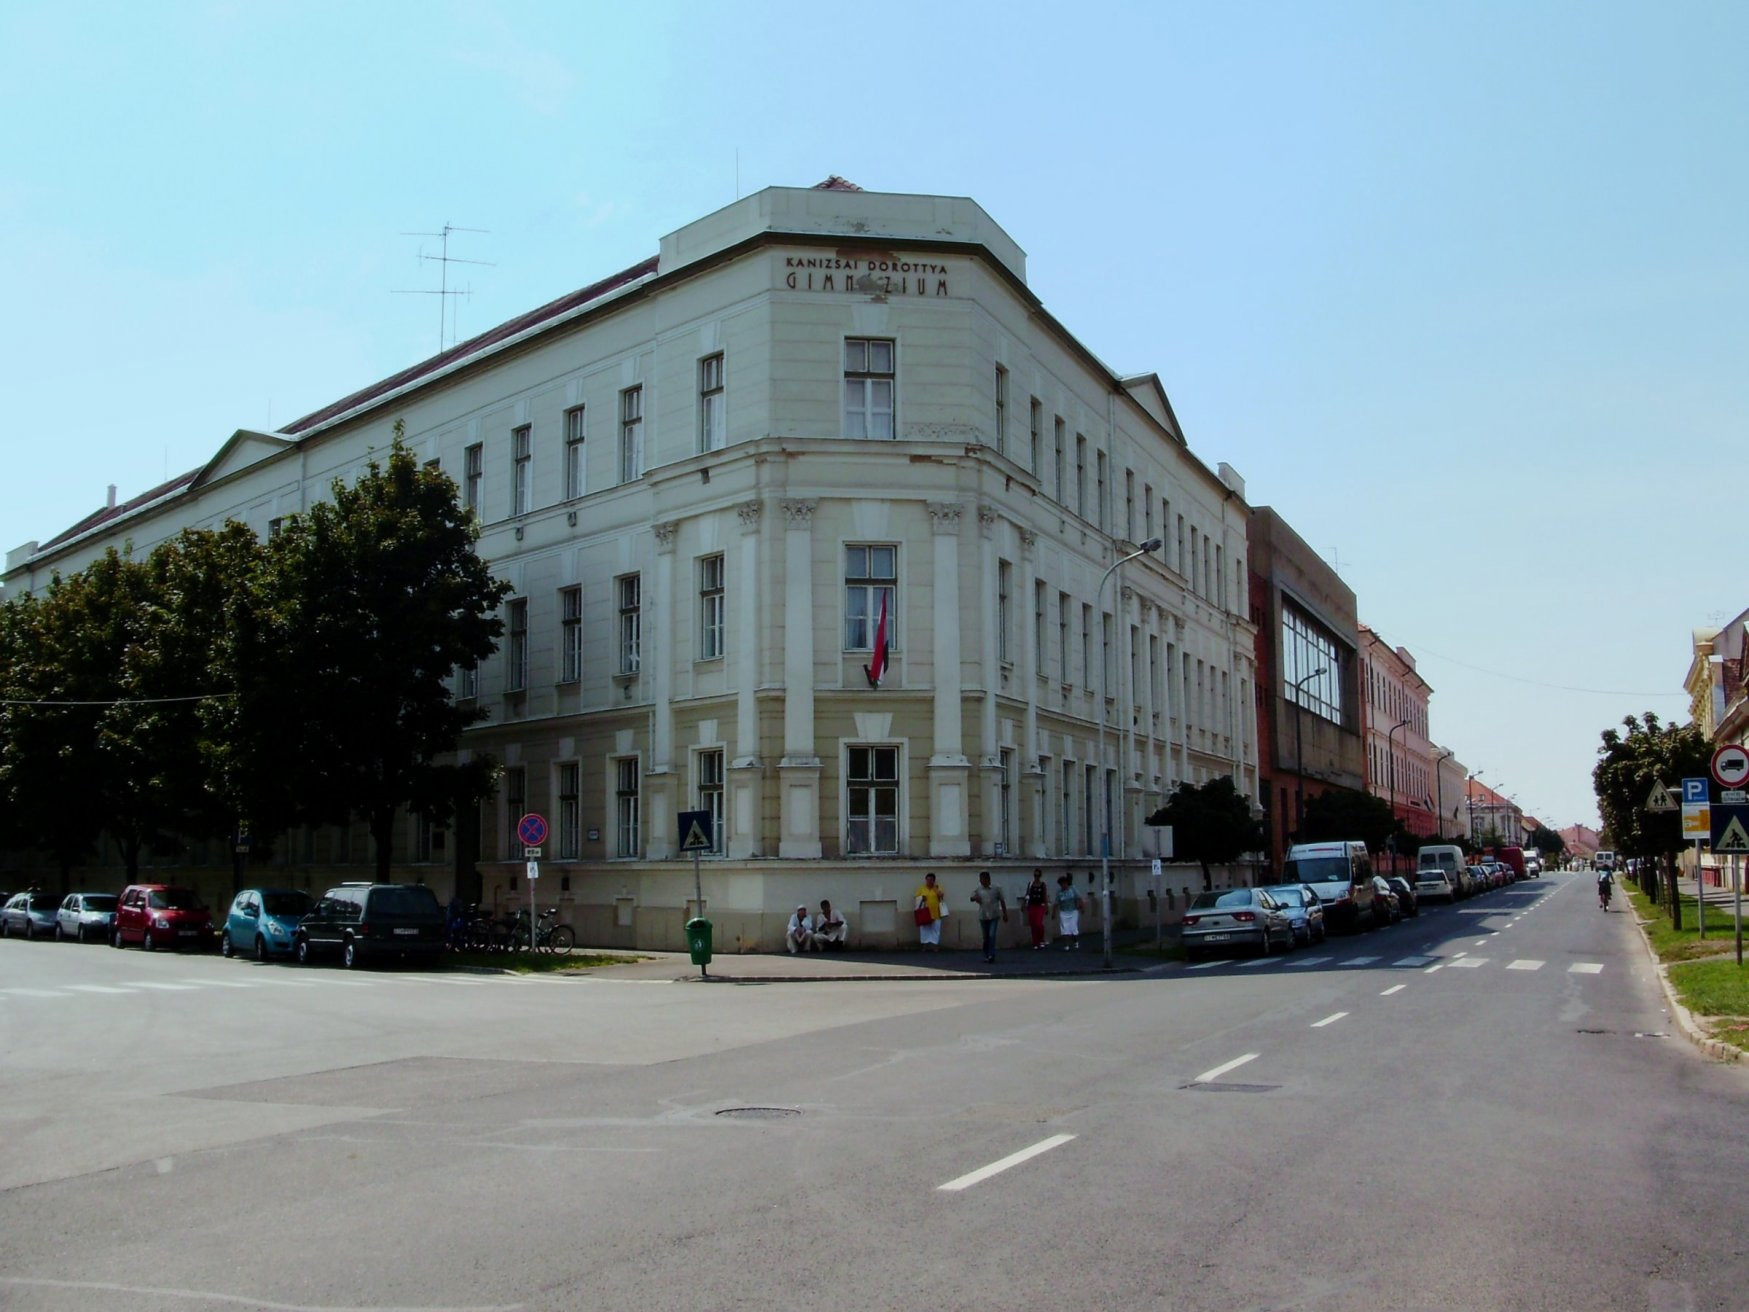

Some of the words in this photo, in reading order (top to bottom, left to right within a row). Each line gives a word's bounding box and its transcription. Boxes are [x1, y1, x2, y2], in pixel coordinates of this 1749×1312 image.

[786, 257, 858, 270] KANIZSAI
[868, 261, 948, 274] DOROTTYA
[786, 272, 948, 296] GIMNZIUM
[1687, 782, 1702, 800] P
